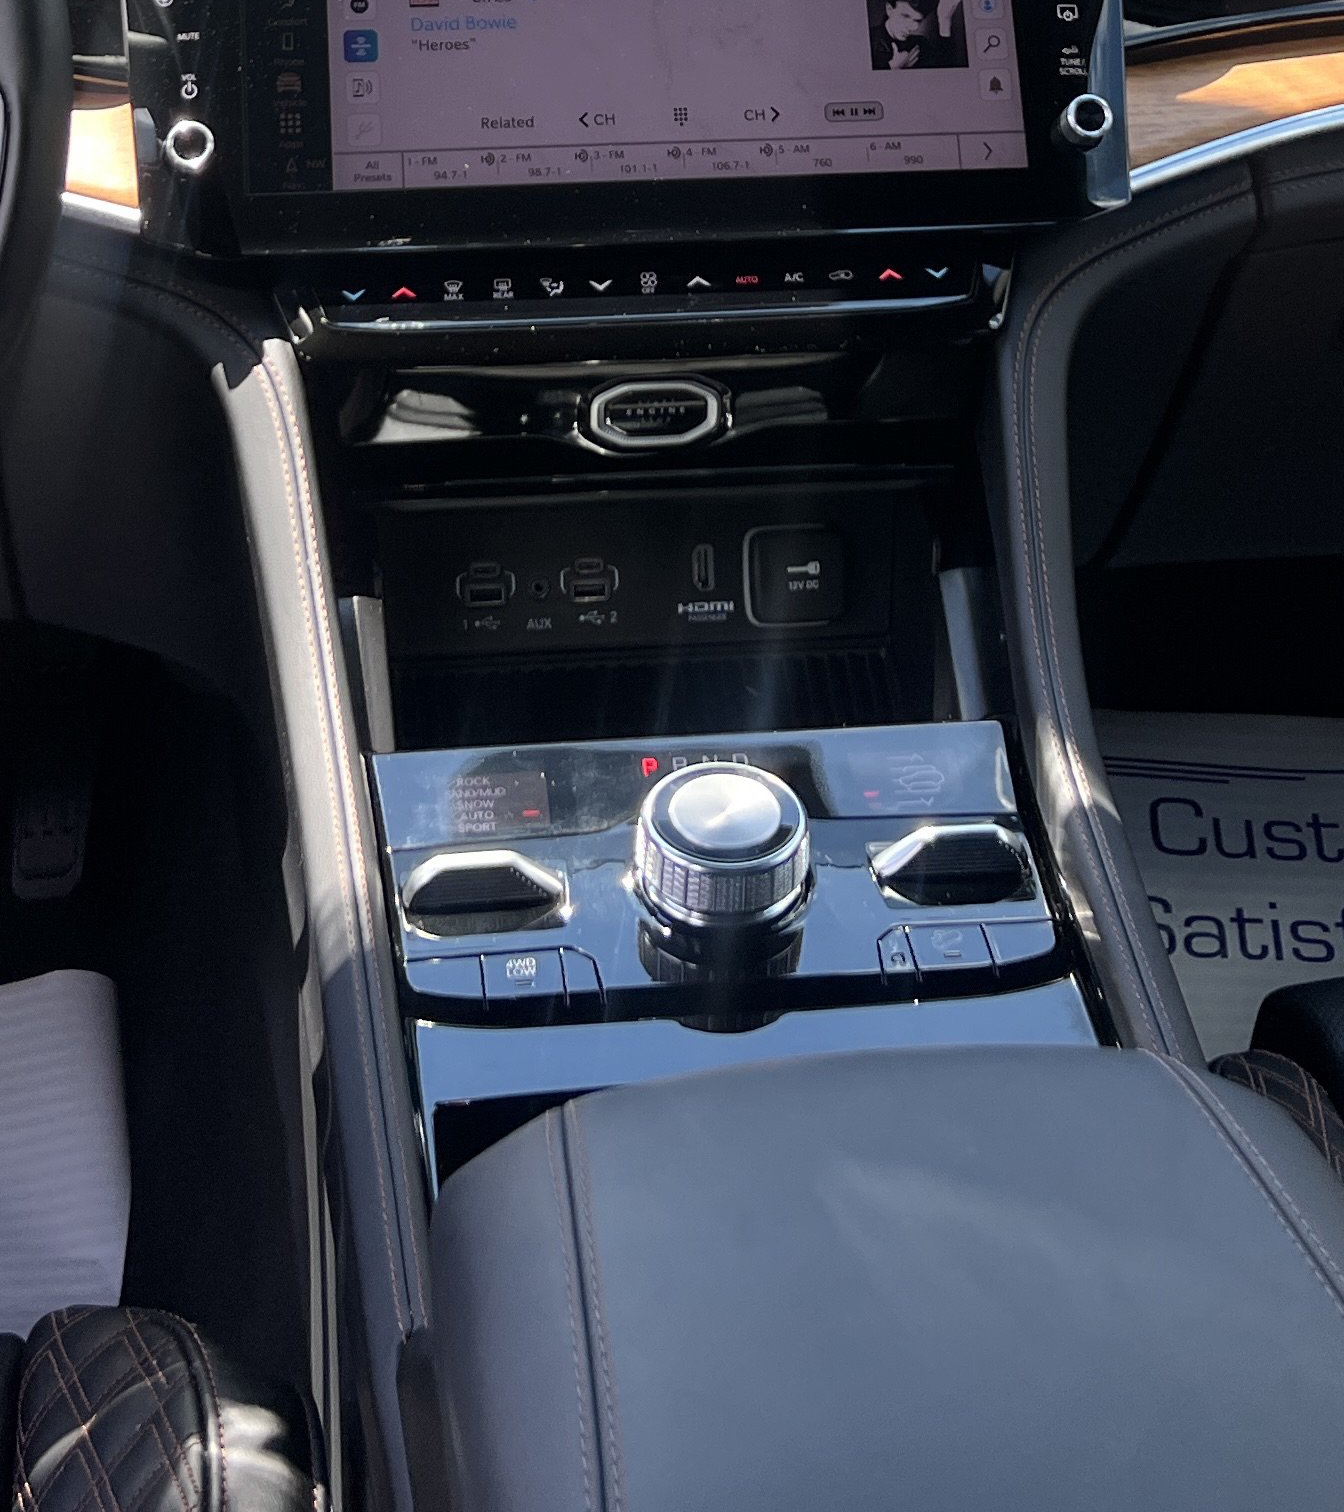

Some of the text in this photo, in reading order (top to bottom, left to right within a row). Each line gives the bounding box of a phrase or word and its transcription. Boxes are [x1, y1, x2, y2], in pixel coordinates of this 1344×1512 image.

[410, 15, 518, 32] David Bowie
[177, 32, 200, 40] MUTE
[411, 38, 477, 51] "Heroes"
[594, 114, 616, 126] CH
[744, 109, 766, 121] CH
[480, 116, 535, 129] Related
[793, 144, 810, 153] AM
[885, 141, 902, 150] AM
[609, 150, 625, 159] FM
[701, 147, 717, 156] FM
[421, 156, 438, 166] FM
[516, 153, 532, 162] FM
[813, 158, 833, 167] 760
[904, 155, 924, 165] 990
[365, 159, 380, 170] All
[354, 172, 392, 183] Presets
[735, 275, 759, 284] AUTO
[784, 273, 804, 283] A/C
[677, 600, 735, 614] HDMI
[610, 611, 618, 624] 2
[526, 618, 552, 630] AUX
[641, 756, 659, 777] P
[460, 810, 495, 820] AUTO
[457, 822, 497, 833] SPORT
[506, 957, 536, 968] 4WD
[506, 967, 536, 978] LOW
